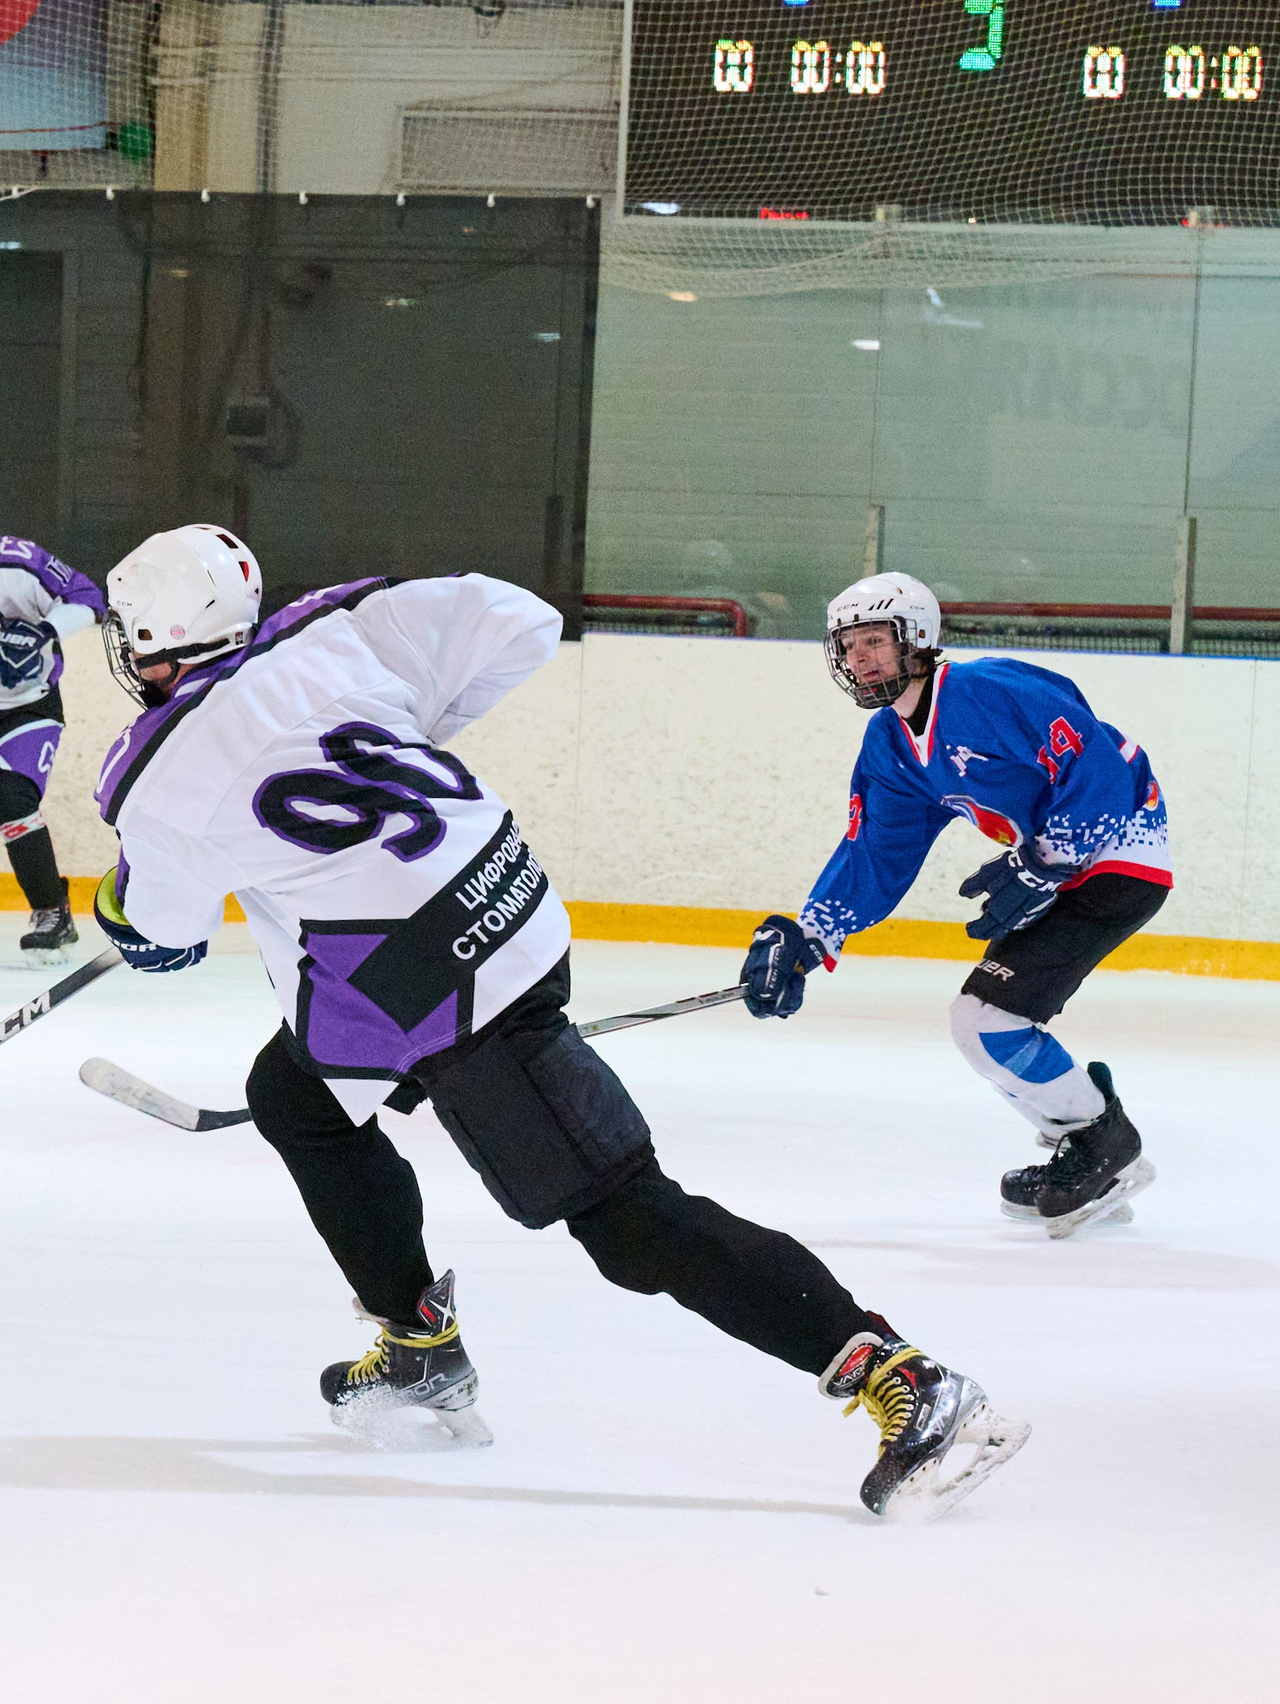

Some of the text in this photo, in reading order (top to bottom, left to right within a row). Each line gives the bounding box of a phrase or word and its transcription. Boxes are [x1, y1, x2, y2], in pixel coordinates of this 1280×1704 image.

[791, 40, 886, 94] 00:00
[1163, 45, 1262, 99] 00:00
[837, 602, 859, 612] CCM
[251, 720, 484, 863] 96
[1008, 847, 1062, 892] CCM
